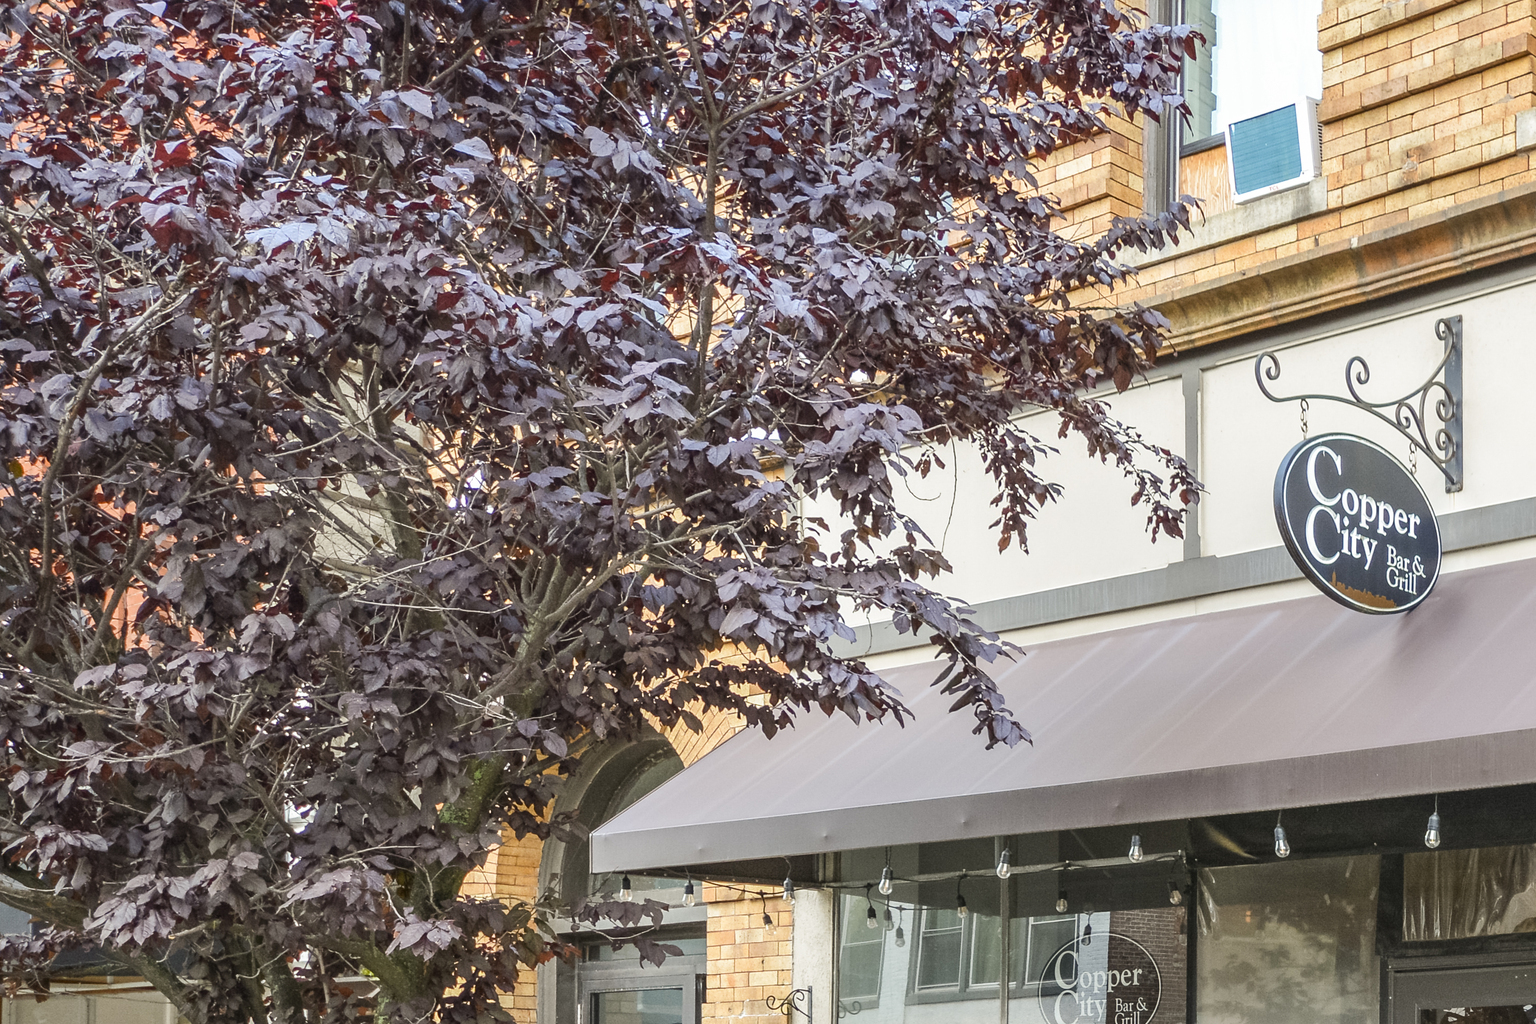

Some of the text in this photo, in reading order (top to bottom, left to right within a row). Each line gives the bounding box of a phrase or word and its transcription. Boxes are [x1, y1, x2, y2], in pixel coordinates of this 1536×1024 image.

[1306, 445, 1421, 539] Copper
[1305, 504, 1378, 571] City
[1386, 544, 1427, 579] Bar &
[1386, 567, 1418, 596] Grill
[1054, 950, 1143, 993] Copper
[1115, 997, 1148, 1013] Bar &
